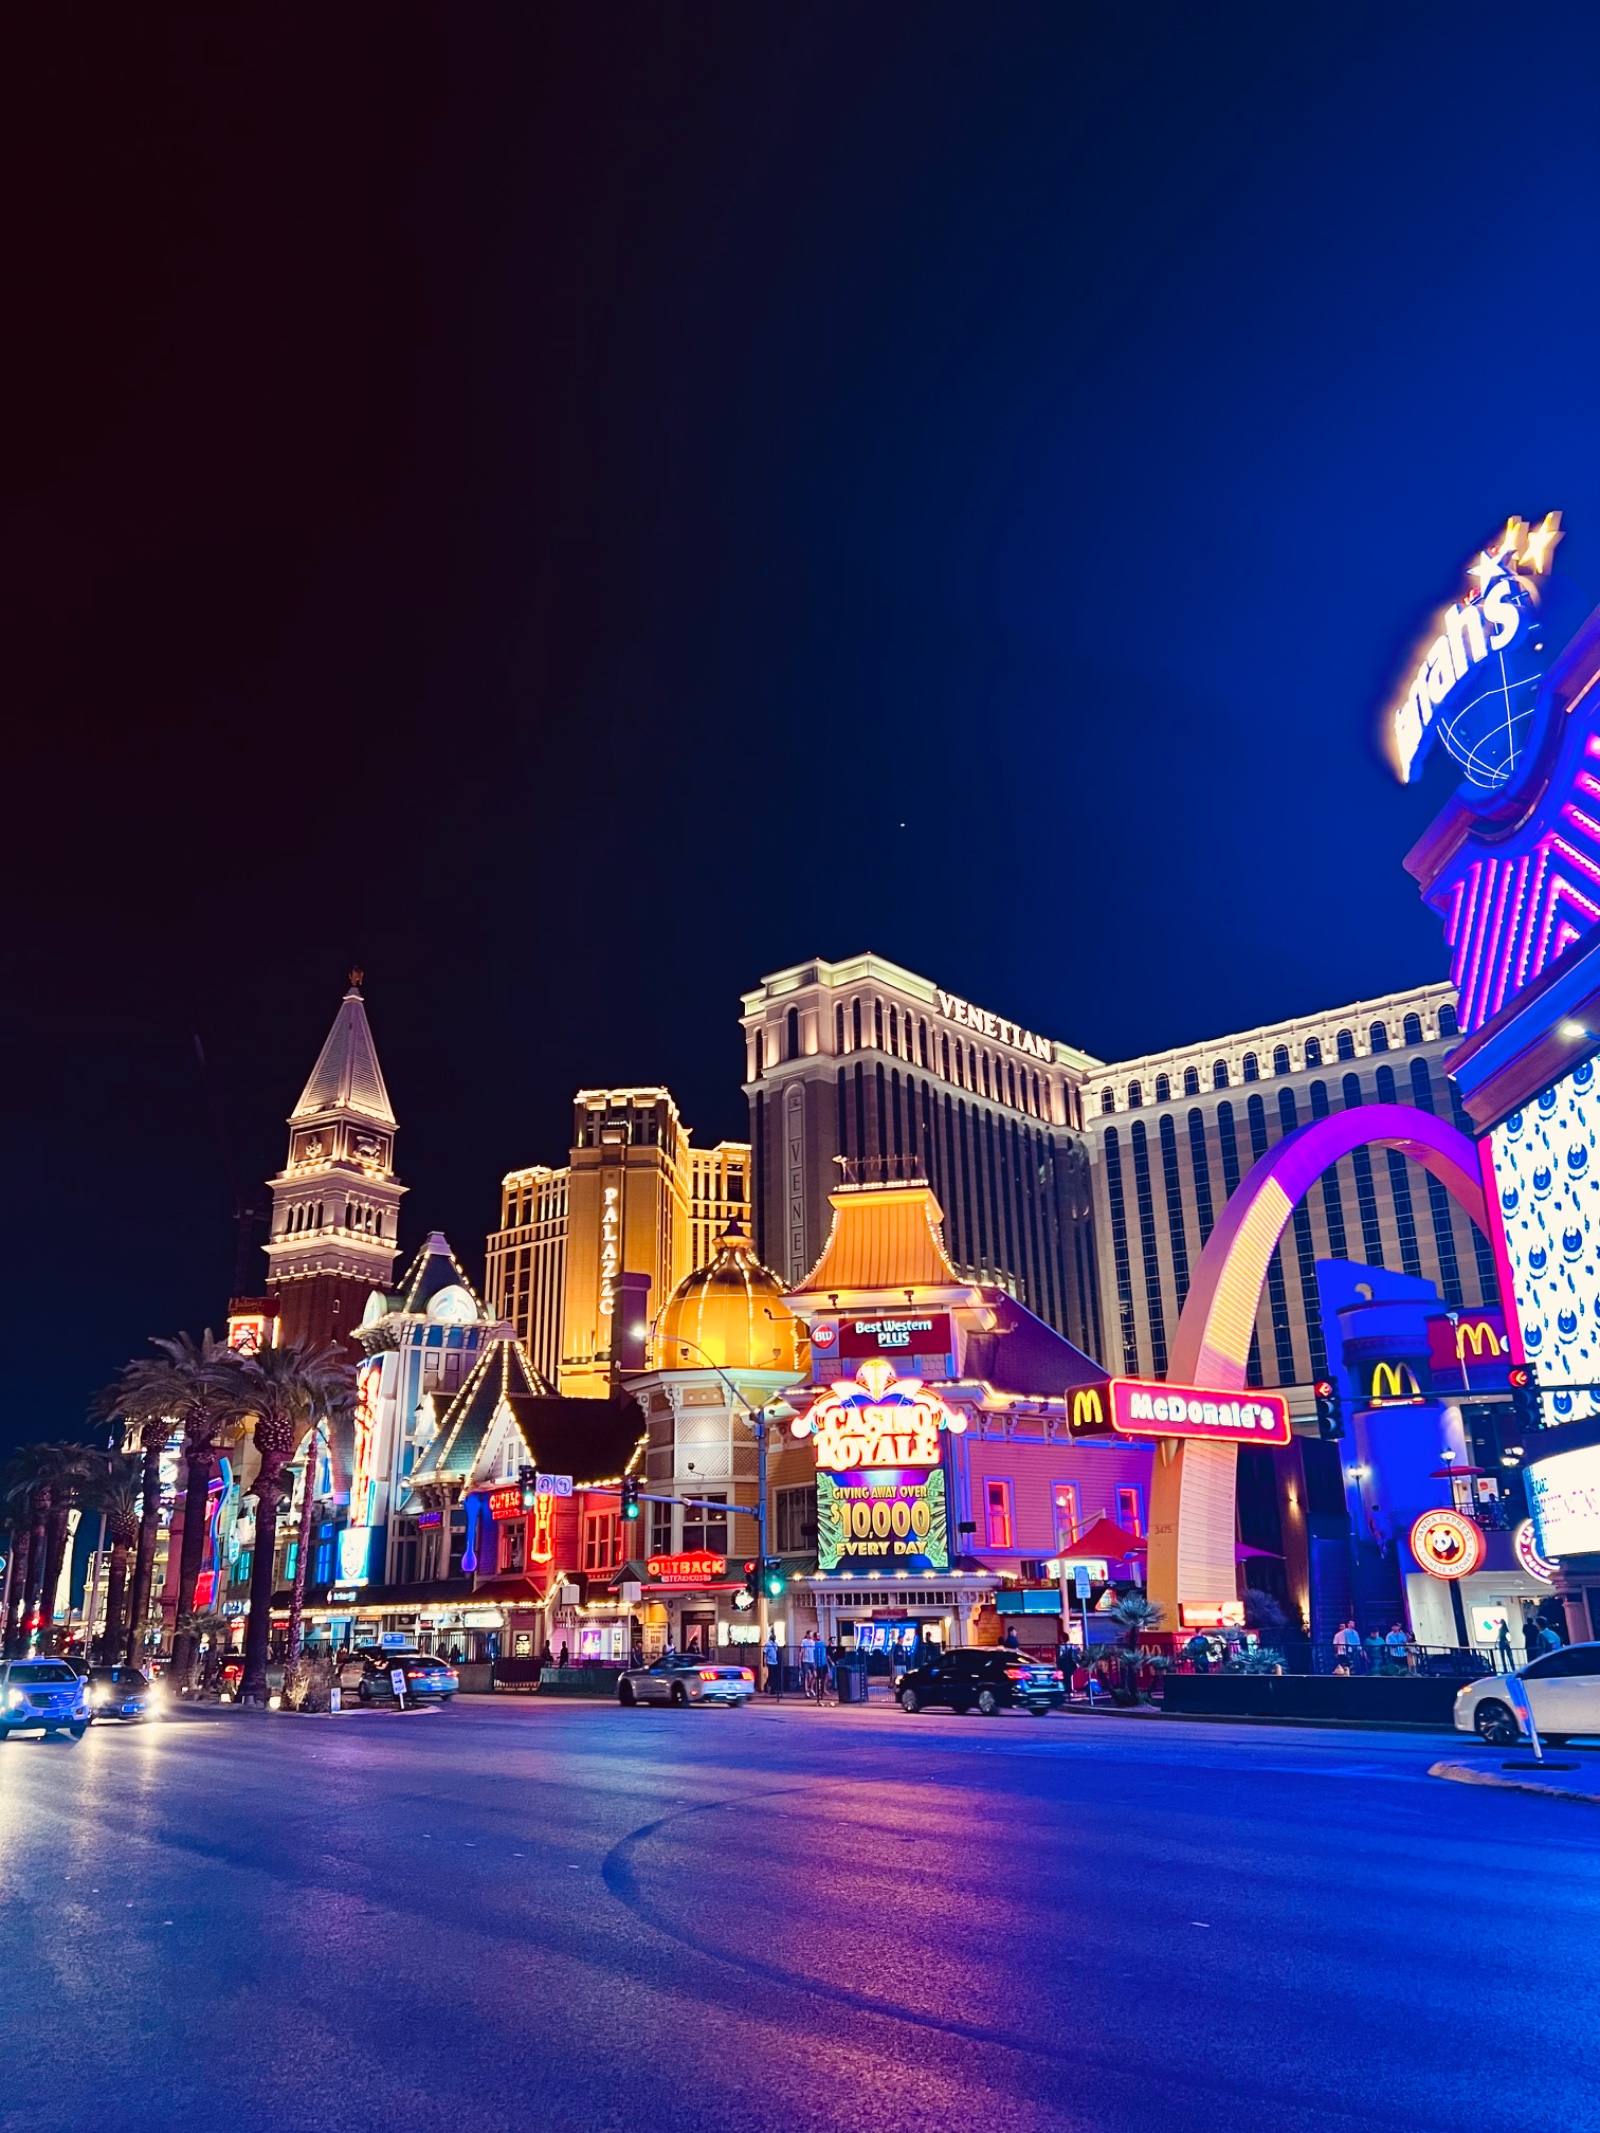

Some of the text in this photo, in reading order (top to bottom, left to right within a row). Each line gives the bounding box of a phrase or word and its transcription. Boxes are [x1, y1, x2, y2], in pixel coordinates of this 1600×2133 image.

[938, 989, 1051, 1062] VENETIAN
[599, 1187, 618, 1315] PALAZZO
[855, 1320, 932, 1334] Best Western
[878, 1332, 910, 1345] PLUS
[823, 1404, 933, 1438] CASINO
[1131, 1393, 1275, 1430] McDonald's
[813, 1428, 940, 1471] ROYALE
[832, 1485, 928, 1500] GIVING AWAY OVER
[831, 1501, 930, 1539] $10,000
[1417, 1514, 1473, 1542] PANDA EXPRESS
[836, 1541, 928, 1556] EVERY DAY
[1420, 1552, 1473, 1572] CHINESE KITCHEN
[648, 1561, 723, 1576] OUTBACK
